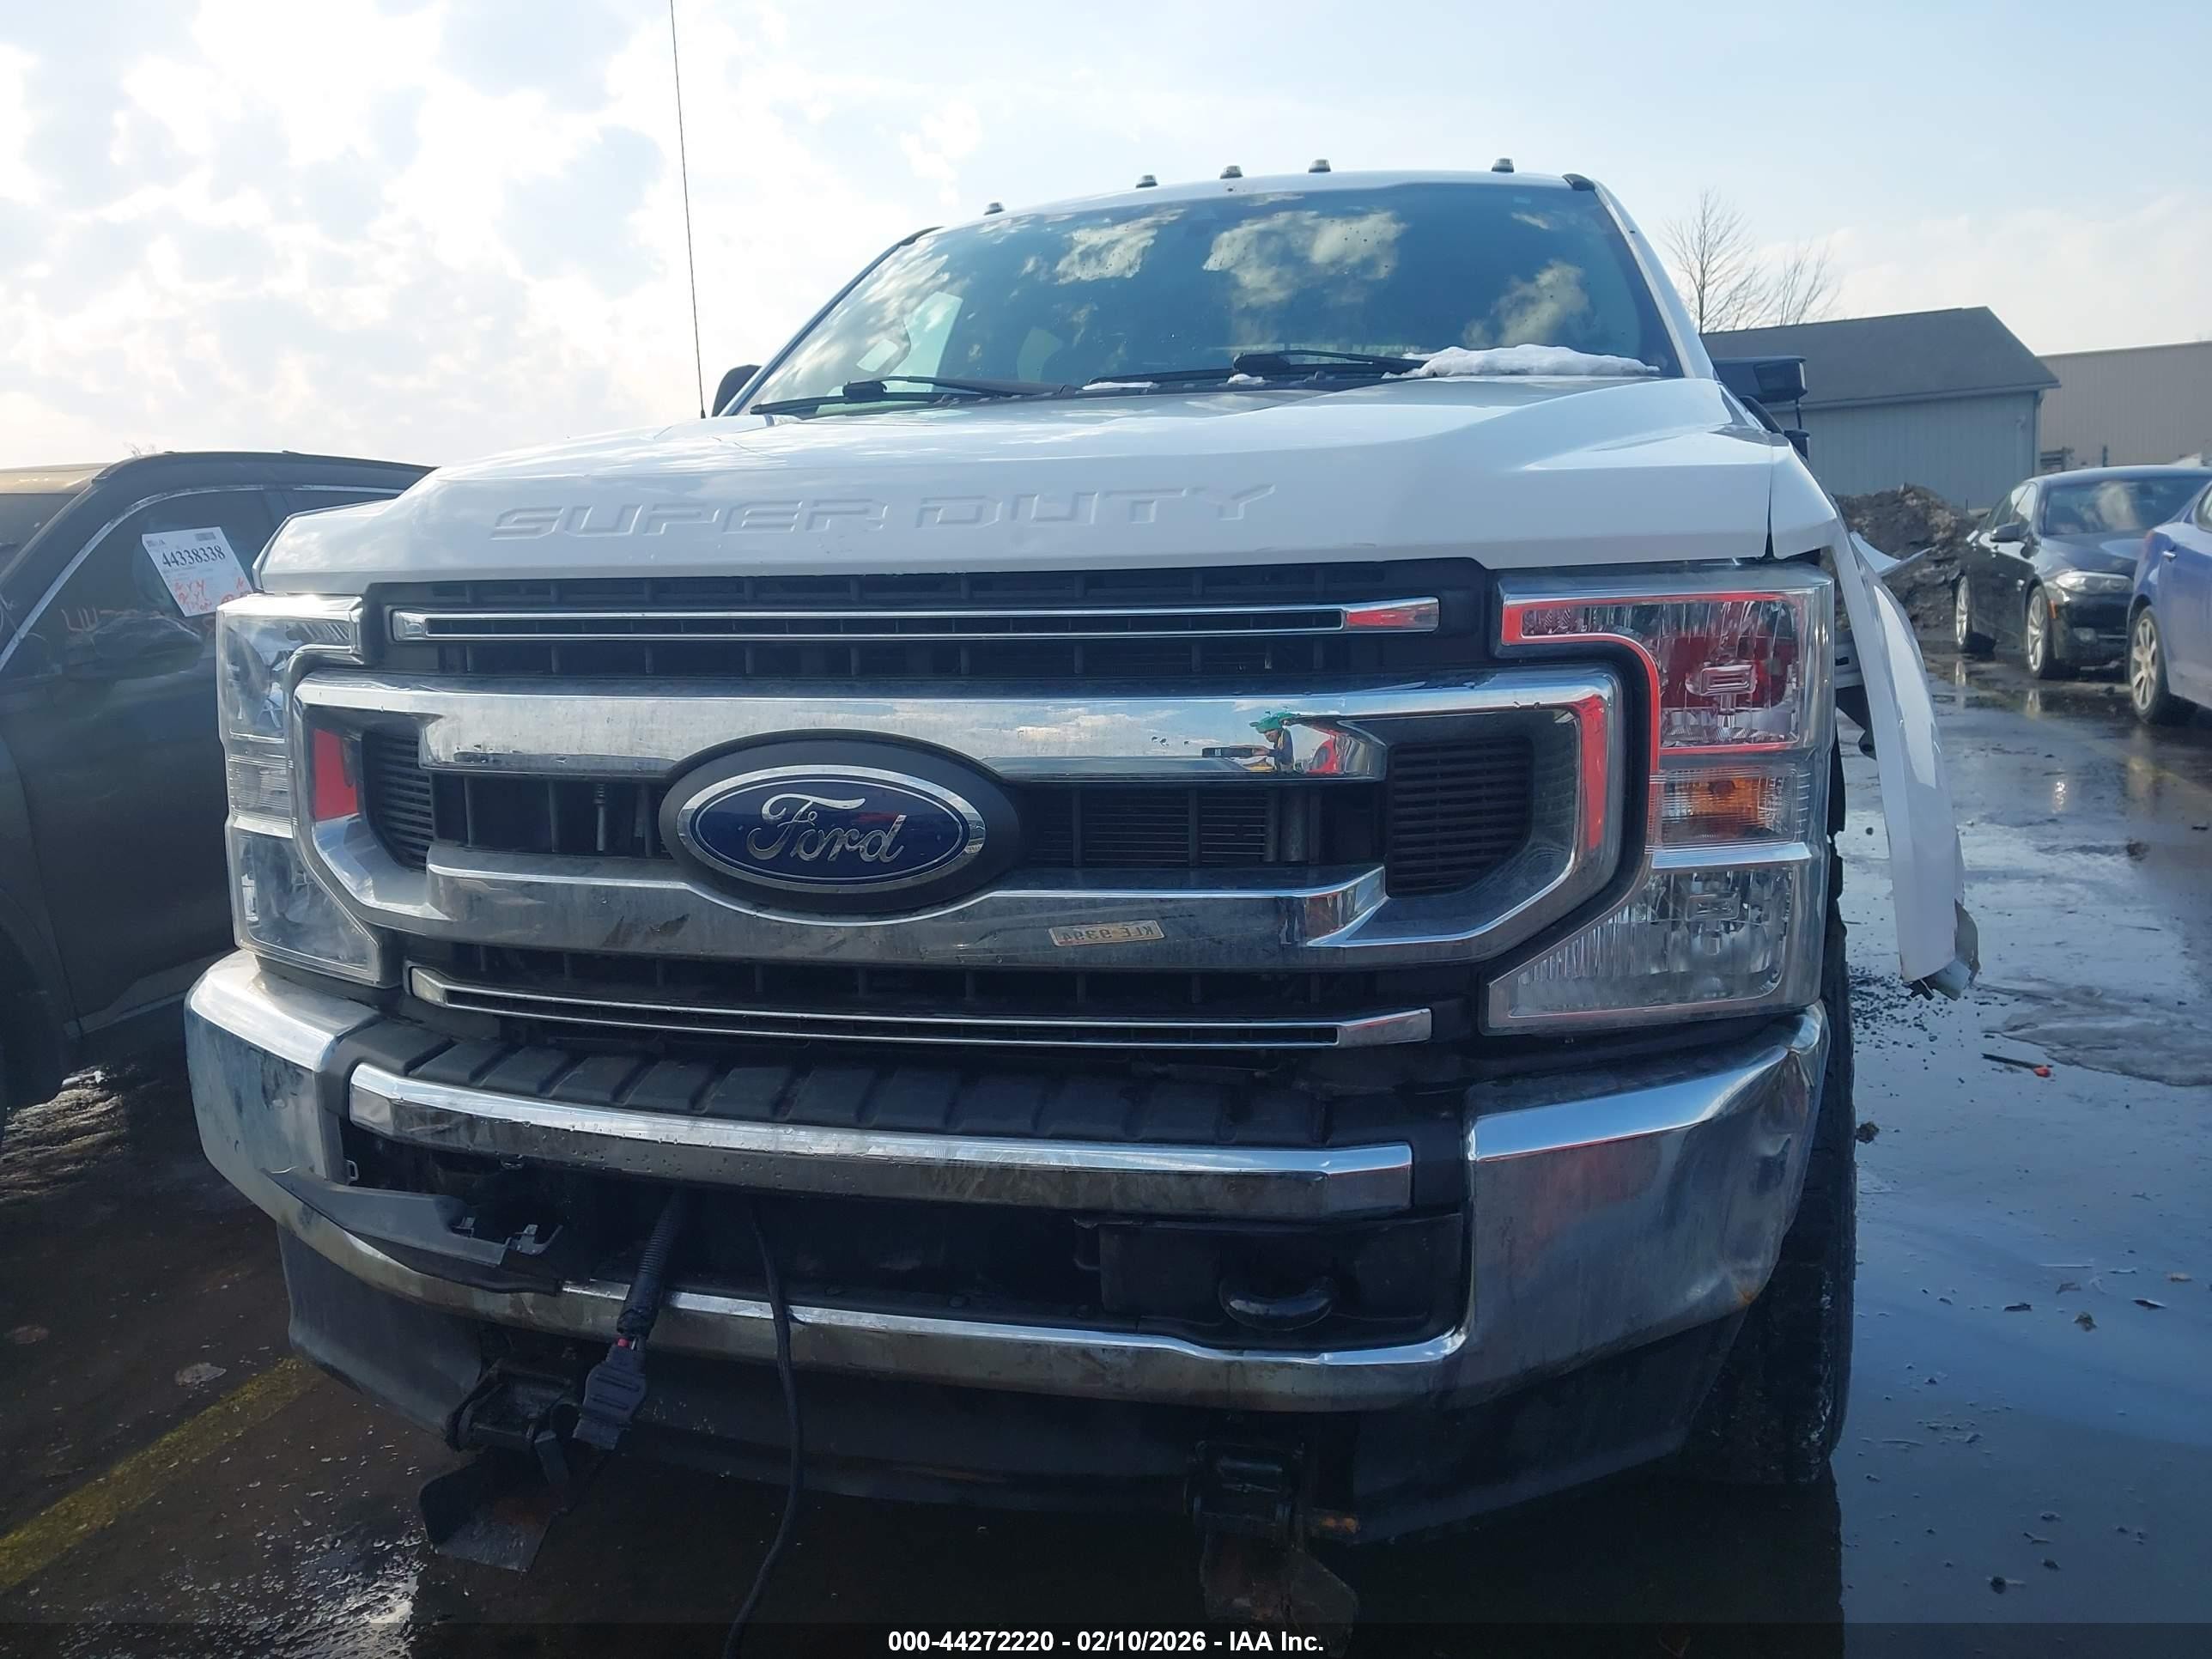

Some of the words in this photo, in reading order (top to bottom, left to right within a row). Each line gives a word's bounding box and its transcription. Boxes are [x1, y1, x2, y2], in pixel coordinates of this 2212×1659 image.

[490, 499, 889, 541] SUPER
[915, 483, 1277, 529] DUTY
[162, 544, 227, 568] 44338338
[746, 793, 907, 863] Ford
